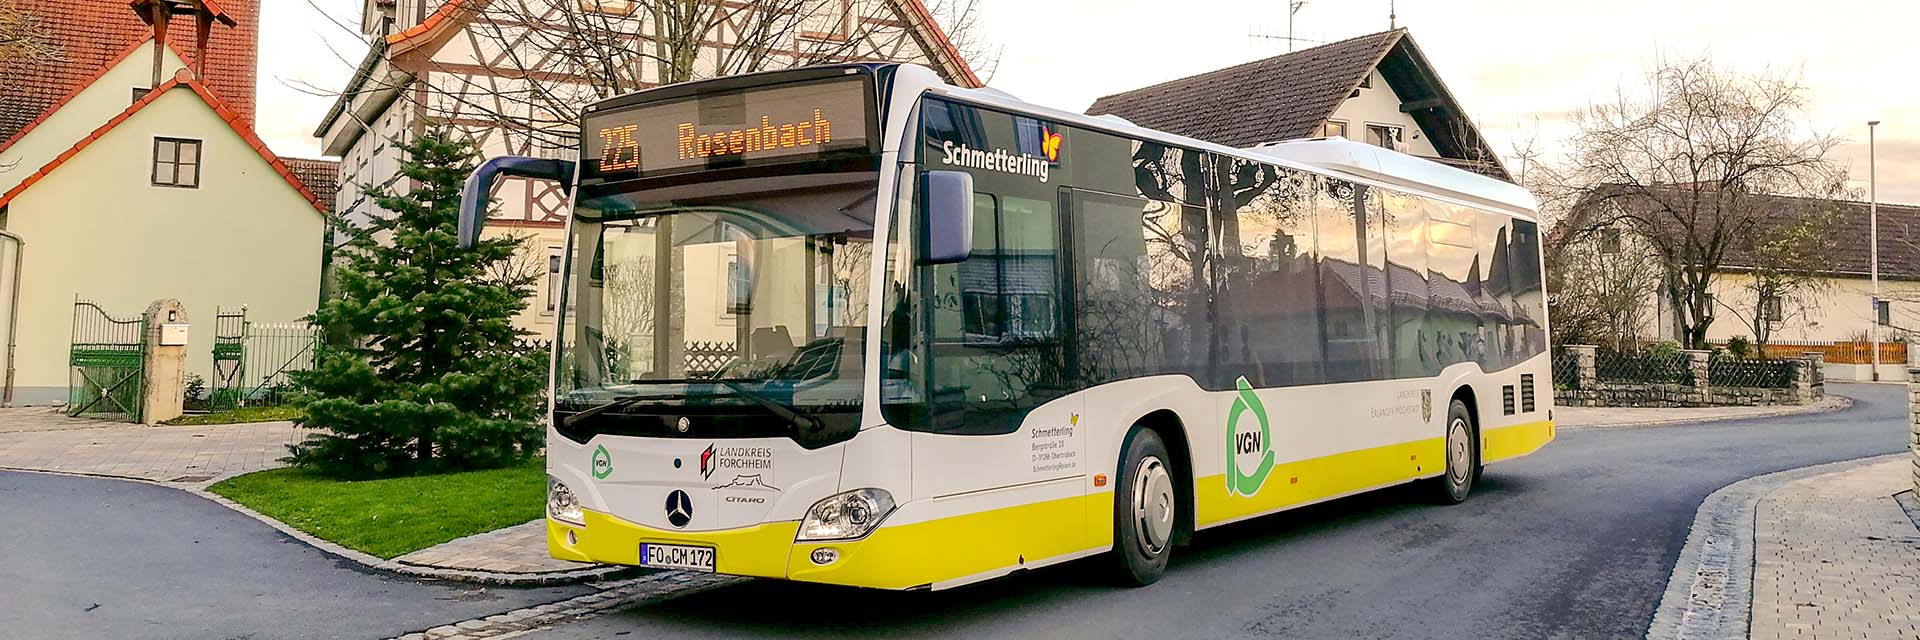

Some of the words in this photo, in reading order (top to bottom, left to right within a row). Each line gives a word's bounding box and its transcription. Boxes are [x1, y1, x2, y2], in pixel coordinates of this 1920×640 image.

[599, 124, 639, 172] 225
[678, 108, 832, 160] Rosenbach
[942, 140, 1049, 183] Schmetterling
[1032, 427, 1073, 438] Schmetterling
[1236, 431, 1261, 455] VGN
[720, 447, 772, 458] LANDKREIS
[595, 459, 607, 467] VGN
[720, 458, 771, 469] FORCHHEIM
[726, 496, 765, 504] CITARO
[648, 546, 664, 563] FO
[672, 548, 688, 565] CM
[690, 549, 712, 567] 172
